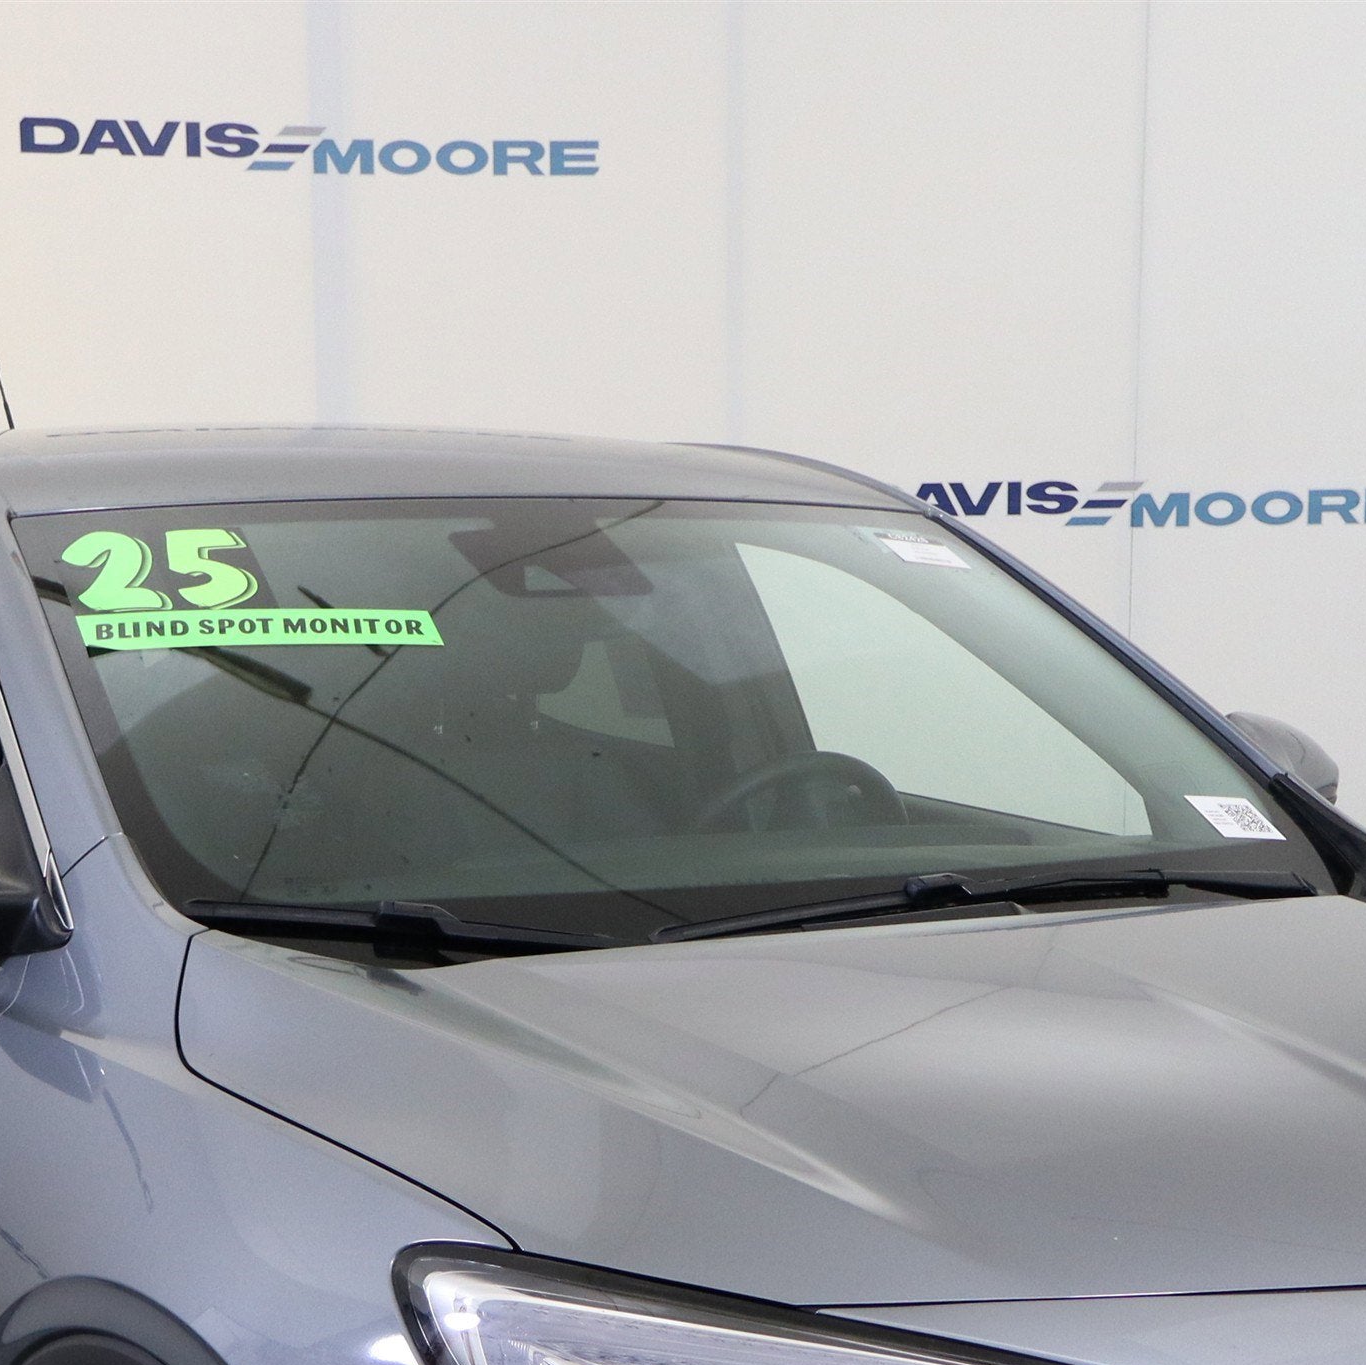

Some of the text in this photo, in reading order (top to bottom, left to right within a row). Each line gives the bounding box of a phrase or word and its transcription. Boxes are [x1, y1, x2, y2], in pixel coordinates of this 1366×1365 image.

[19, 116, 600, 177] DAVIS MOORE
[61, 527, 259, 612] 25
[94, 616, 425, 641] BLIND SPOT MONITOR
